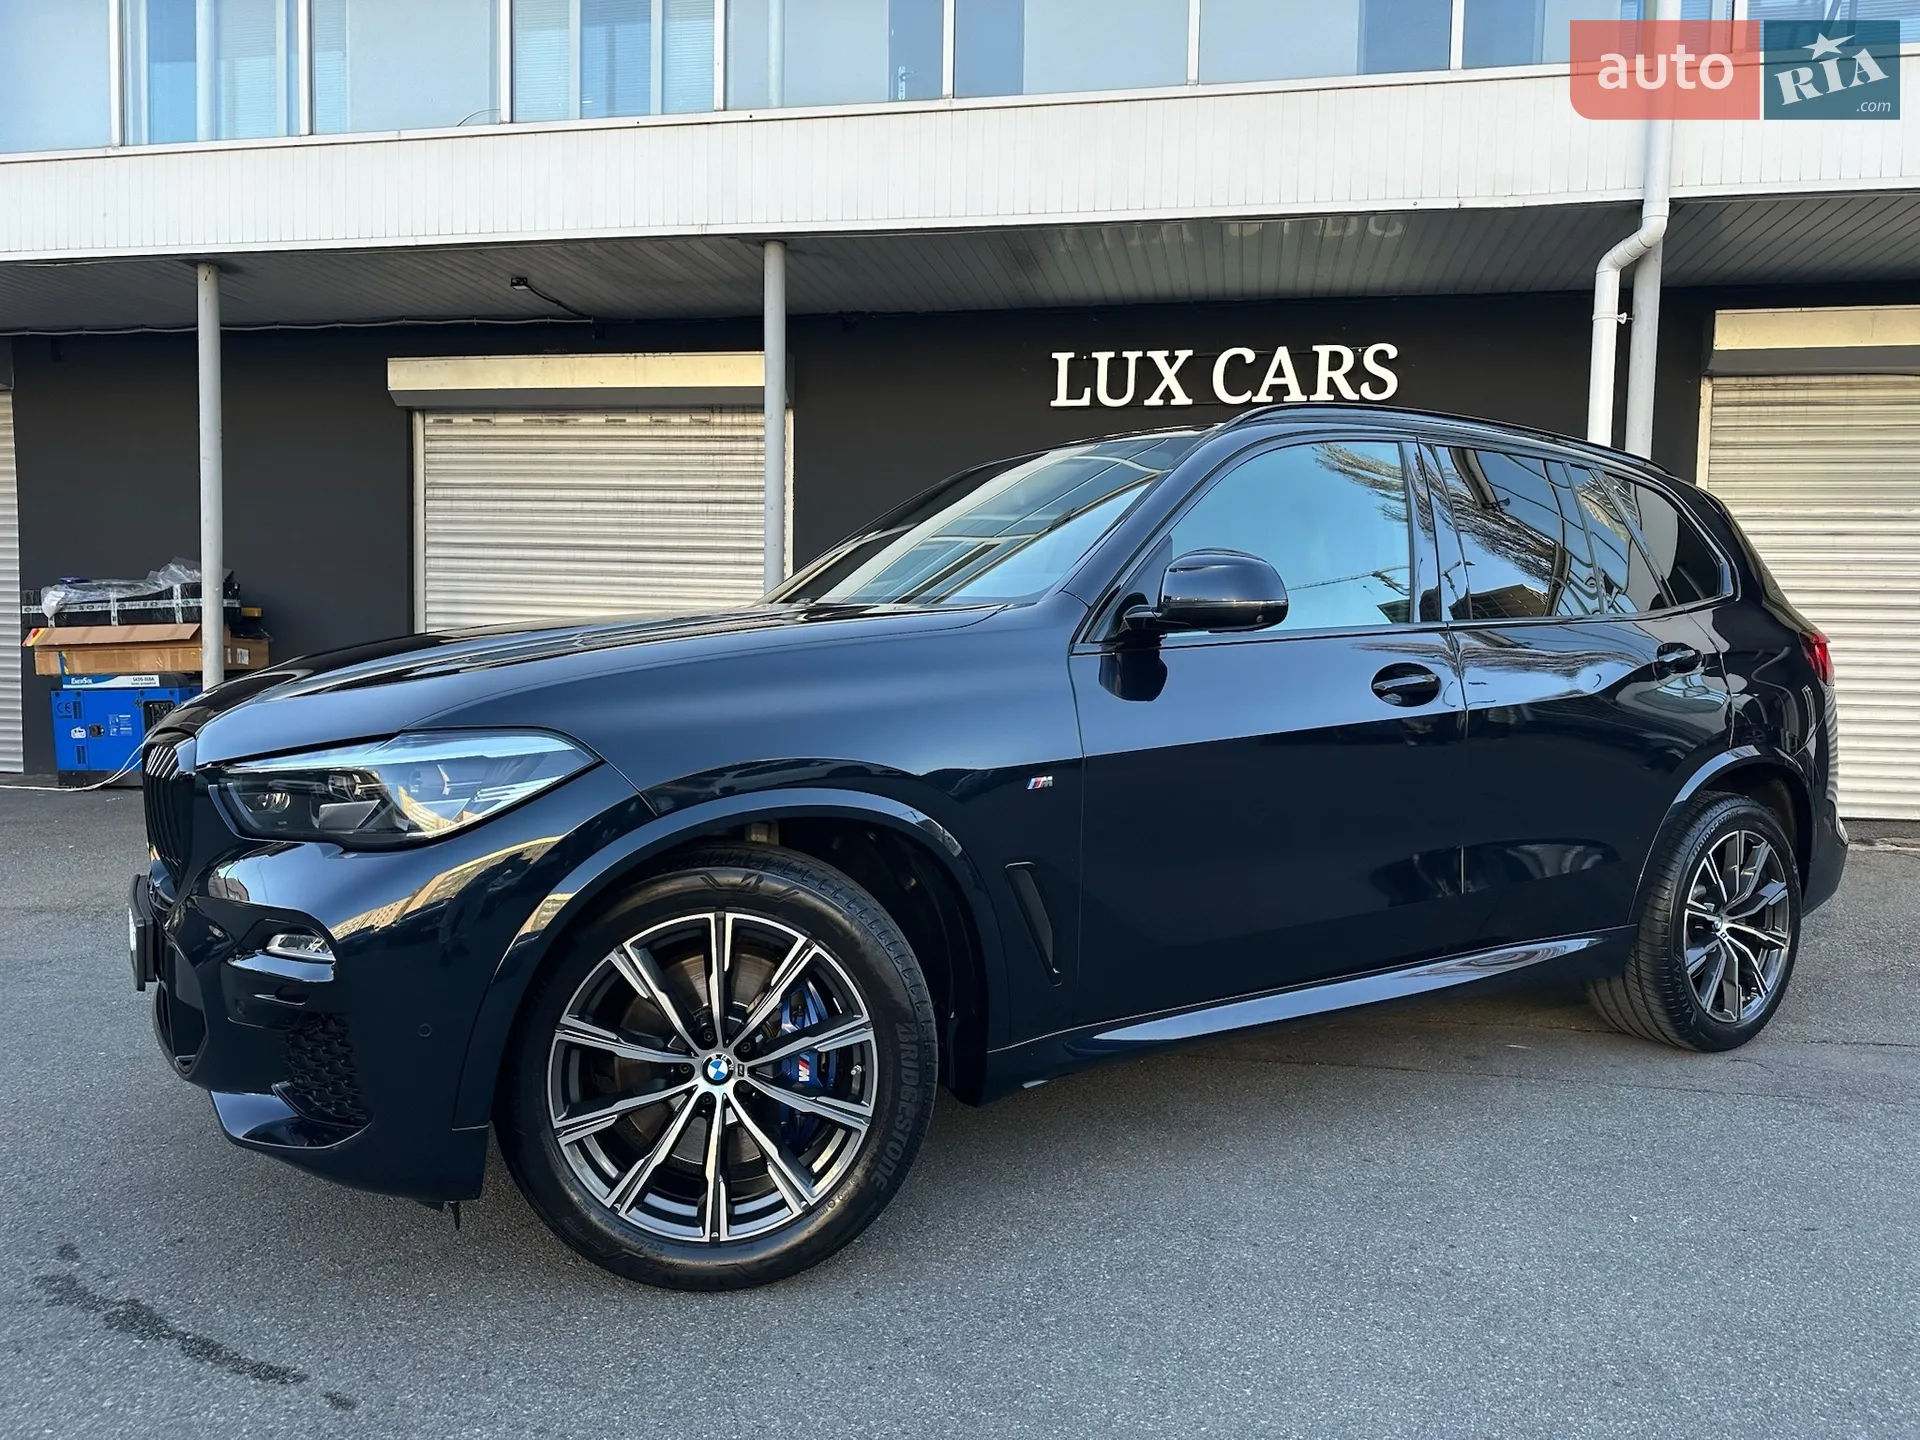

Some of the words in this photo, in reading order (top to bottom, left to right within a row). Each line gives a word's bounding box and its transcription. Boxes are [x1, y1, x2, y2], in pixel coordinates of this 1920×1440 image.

[1050, 349, 1193, 407] LUX
[1212, 342, 1399, 405] CARS
[870, 1022, 920, 1191] BRIDGESTONE
